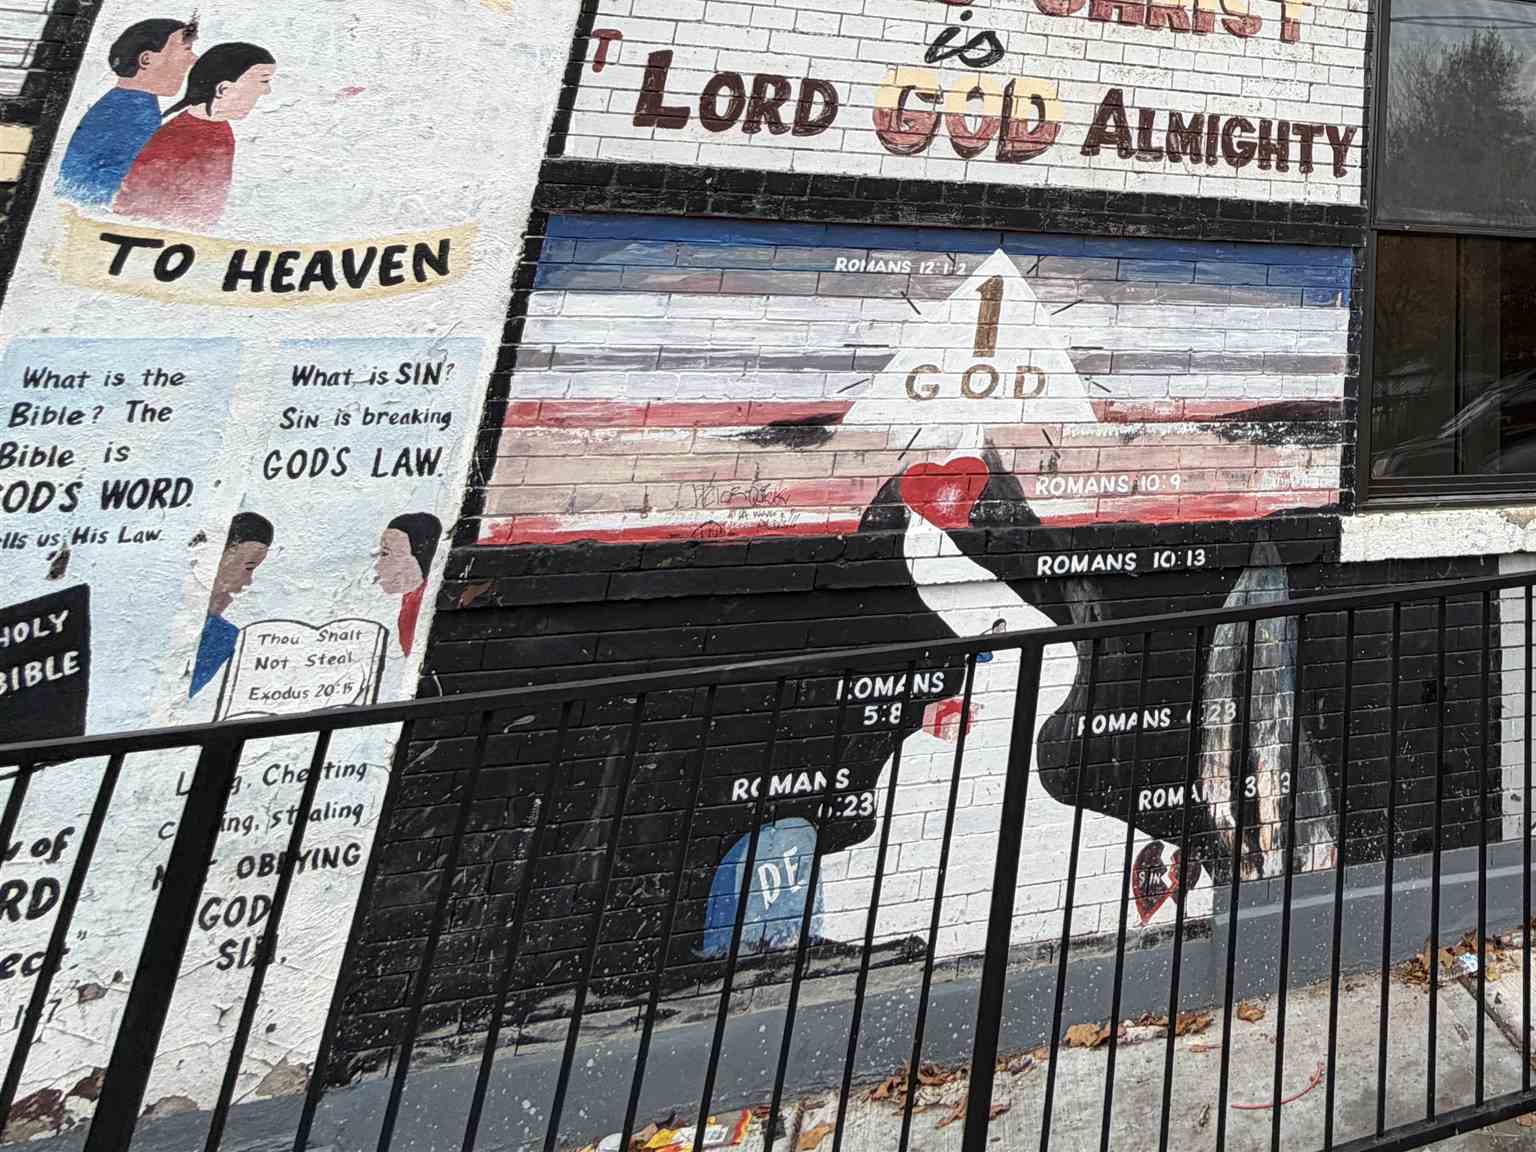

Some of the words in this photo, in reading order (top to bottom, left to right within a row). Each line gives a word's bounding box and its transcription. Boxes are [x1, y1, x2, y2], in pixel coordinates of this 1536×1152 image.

[924, 9, 1006, 68] is
[632, 48, 839, 137] LORD
[874, 68, 1065, 164] GOD
[1080, 88, 1359, 178] ALMIGHTY
[99, 231, 196, 283] TO
[222, 236, 453, 293] HEAVEN
[834, 256, 912, 274] ROMANS
[974, 274, 1004, 357] 1
[23, 366, 90, 389] What
[104, 370, 125, 388] is
[142, 369, 185, 387] the
[292, 365, 353, 387] What
[369, 367, 390, 385] is
[396, 362, 455, 386] SIN?
[905, 363, 1046, 400] GOD
[8, 401, 105, 428] Bible?
[126, 400, 173, 424] The
[335, 406, 351, 427] is
[363, 406, 453, 431] breaking
[0, 443, 74, 470] Bible
[105, 443, 129, 463] is
[370, 447, 445, 480] LAW.
[100, 477, 193, 510] WORD.
[1035, 474, 1131, 496] ROMANS
[1140, 473, 1181, 492] 10:9
[37, 533, 60, 547] us
[72, 526, 109, 545] His
[1036, 551, 1138, 577] ROMANS
[1153, 548, 1205, 569] 10:13
[257, 632, 299, 647] Thou
[318, 627, 364, 644] Shalt
[254, 654, 289, 672] Not
[304, 652, 353, 668] Steal
[248, 686, 309, 702] Exodus
[263, 762, 367, 787] Cheting
[30, 826, 75, 864] of
[198, 894, 272, 931] GOD
